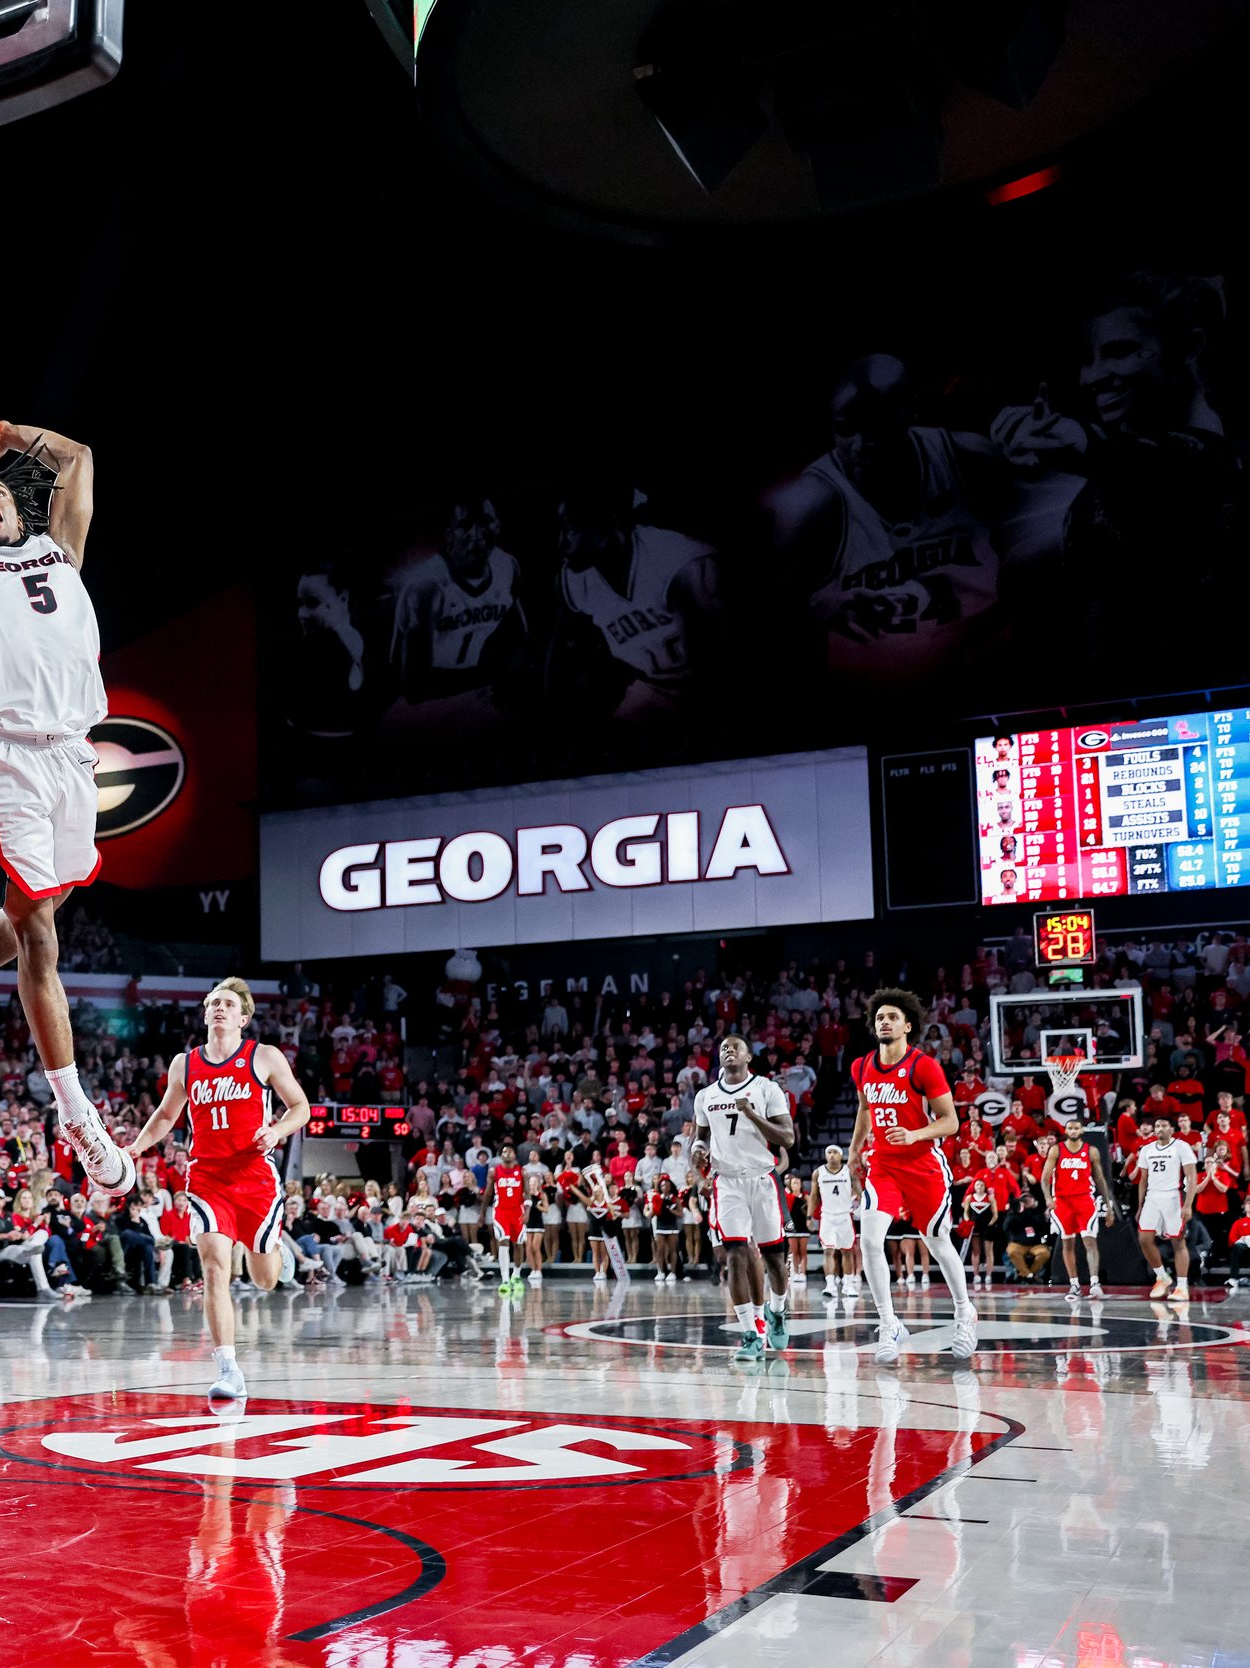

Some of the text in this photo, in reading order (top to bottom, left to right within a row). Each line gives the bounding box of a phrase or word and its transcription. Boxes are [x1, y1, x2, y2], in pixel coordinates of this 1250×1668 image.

[21, 572, 58, 615] 5
[1214, 712, 1233, 722] PTS
[1123, 751, 1161, 764] FOULS
[1192, 746, 1201, 757] 4
[1216, 747, 1235, 758] PTS
[1113, 765, 1173, 781] REBOUNDS
[1189, 761, 1206, 774] 24
[1121, 781, 1166, 795] BLOCKS
[1217, 781, 1238, 792] PTS
[1084, 803, 1093, 814] 4
[1123, 797, 1166, 810] STEALS
[1121, 812, 1169, 826] ASSISTS
[1220, 817, 1240, 828] PTS
[1086, 834, 1095, 845] 4
[1112, 827, 1180, 842] TURNOVERS
[319, 804, 790, 912] GEORGIA
[1222, 852, 1242, 862] PTS
[199, 889, 230, 913] YY
[1046, 915, 1088, 932] 15:04
[1047, 931, 1084, 960] 28
[191, 1076, 252, 1106] Ole Miss
[878, 1082, 909, 1104] Miss
[341, 1106, 379, 1123] 15:04
[708, 1103, 755, 1112] GEOR
[210, 1106, 229, 1130] 11
[726, 1114, 738, 1135] 7
[874, 1107, 898, 1127] 23
[309, 1121, 325, 1134] 52
[361, 1125, 370, 1138] 2
[1071, 1169, 1078, 1180] 4
[1152, 1160, 1166, 1172] 25
[832, 1185, 839, 1196] 4
